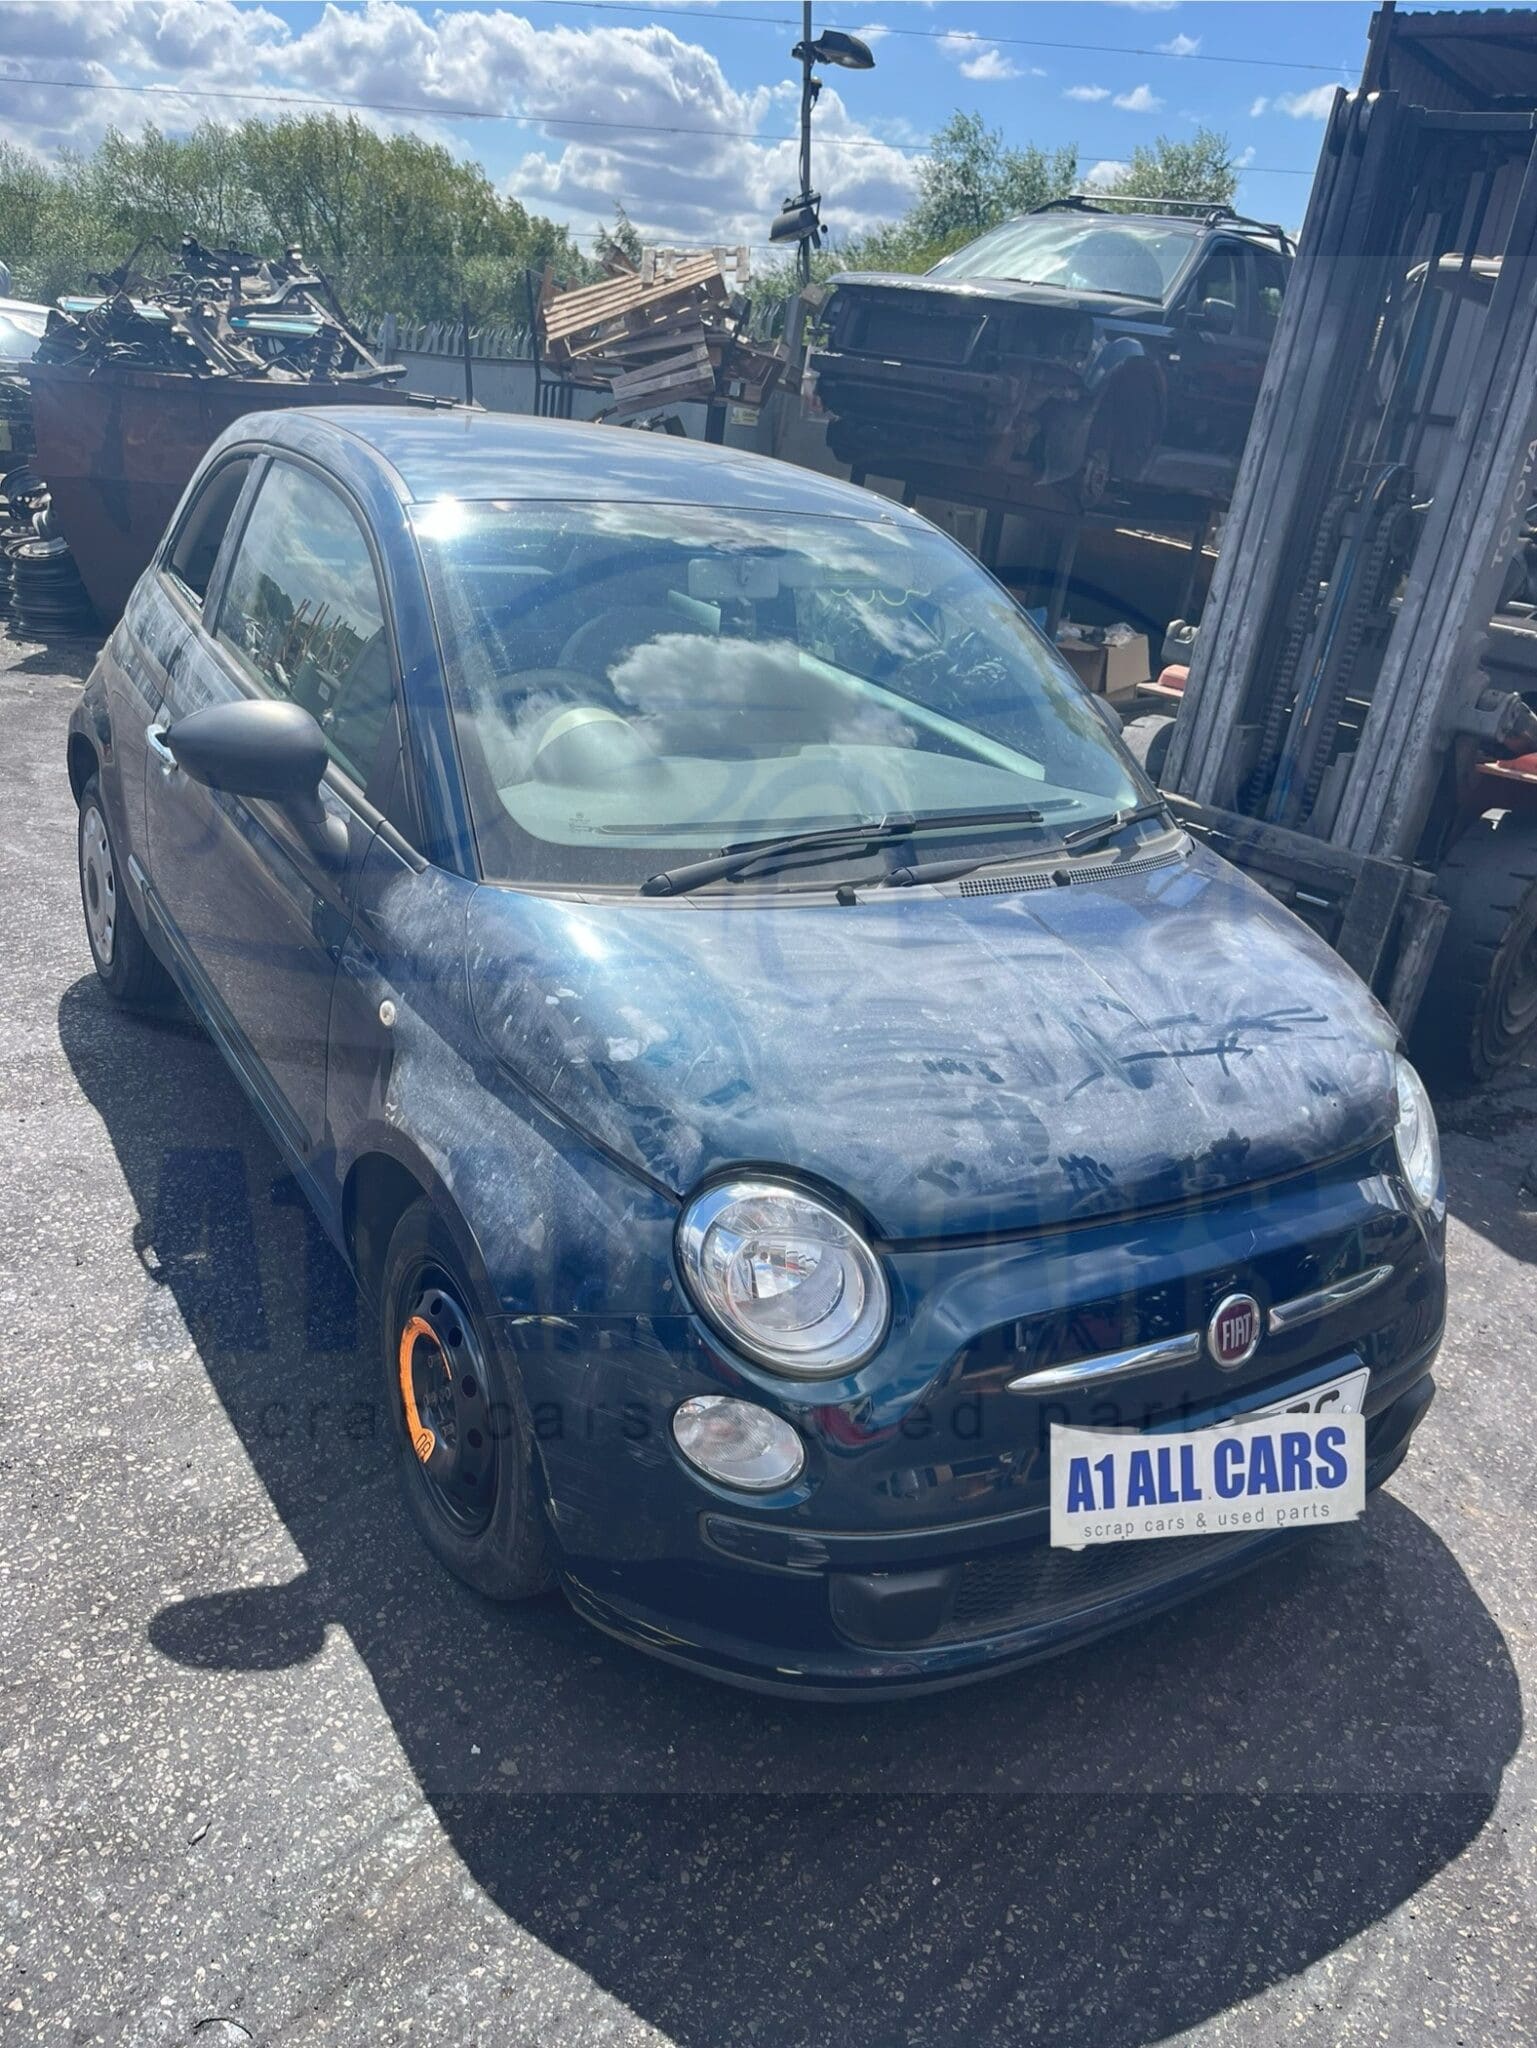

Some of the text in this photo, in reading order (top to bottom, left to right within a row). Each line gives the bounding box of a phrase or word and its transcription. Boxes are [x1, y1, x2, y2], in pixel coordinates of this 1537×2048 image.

[1491, 439, 1537, 569] TOYOTA
[1222, 1312, 1251, 1352] FIAT
[1066, 1426, 1348, 1514] A1 ALL CARS
[1083, 1503, 1330, 1538] scrap cars & used parts
